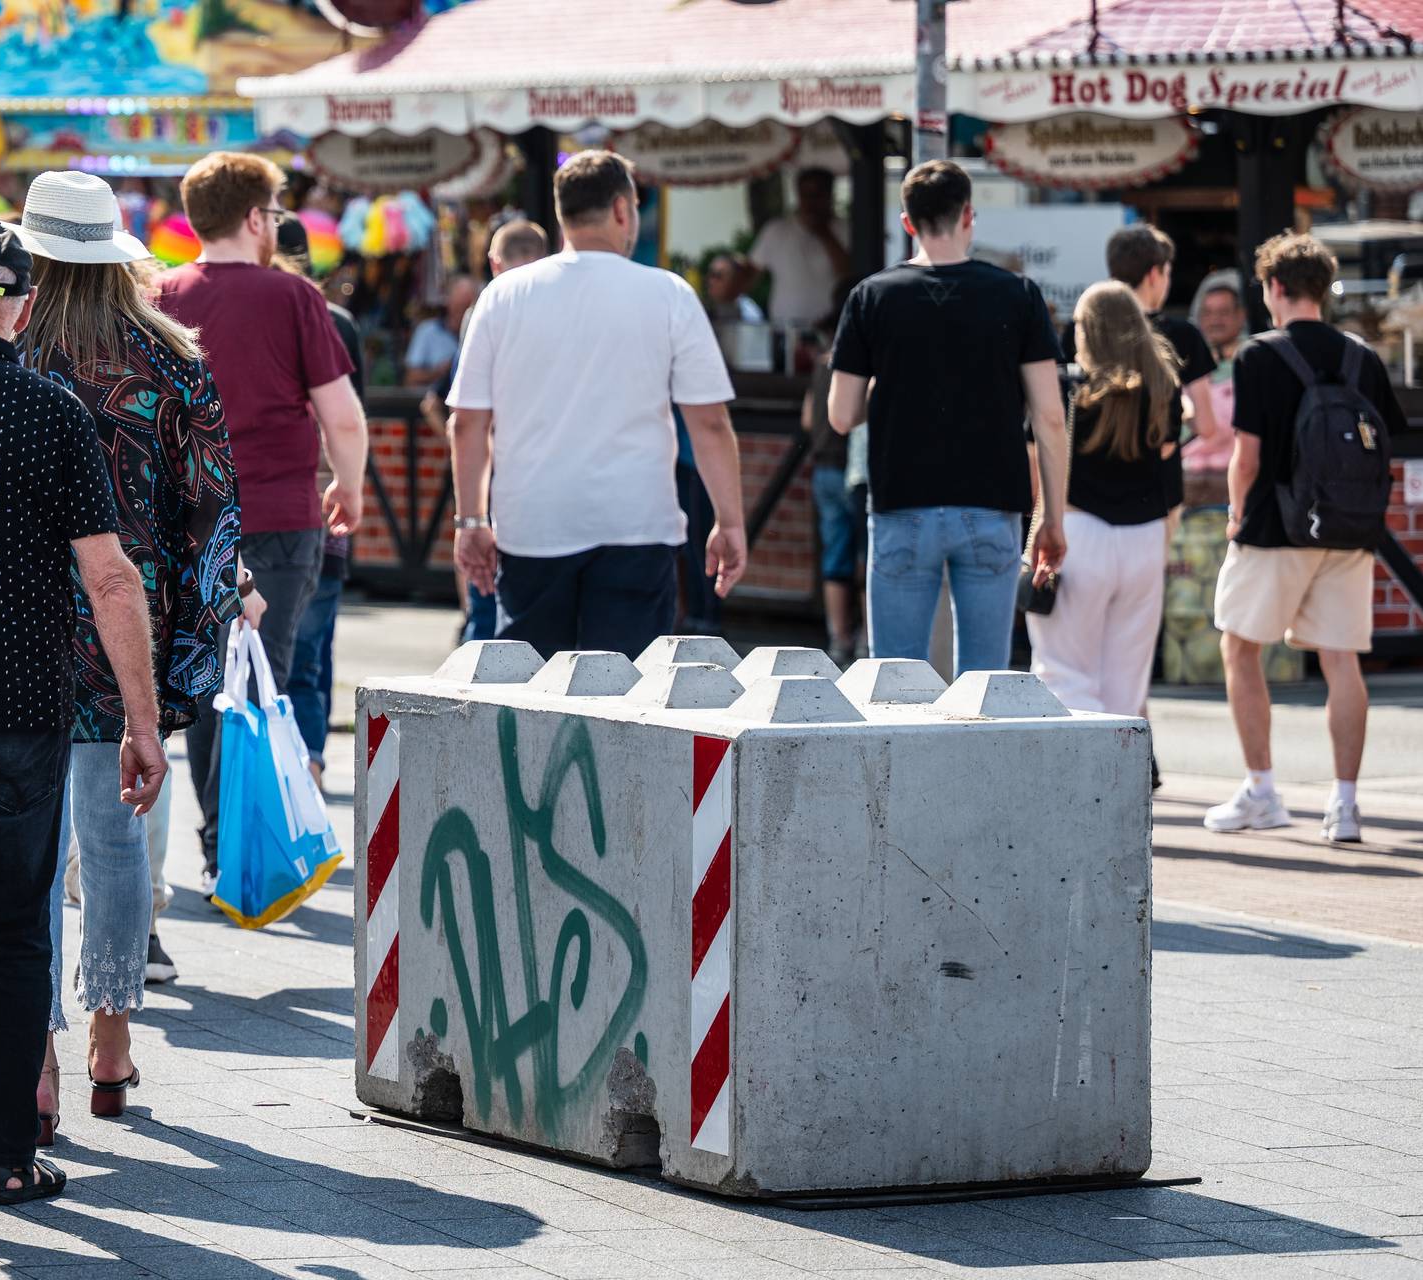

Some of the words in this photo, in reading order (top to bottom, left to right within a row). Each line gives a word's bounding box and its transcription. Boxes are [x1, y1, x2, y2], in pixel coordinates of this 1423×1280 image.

[1051, 72, 1111, 105] Hot
[1126, 70, 1187, 110] Dog
[1197, 65, 1349, 107] Spezial
